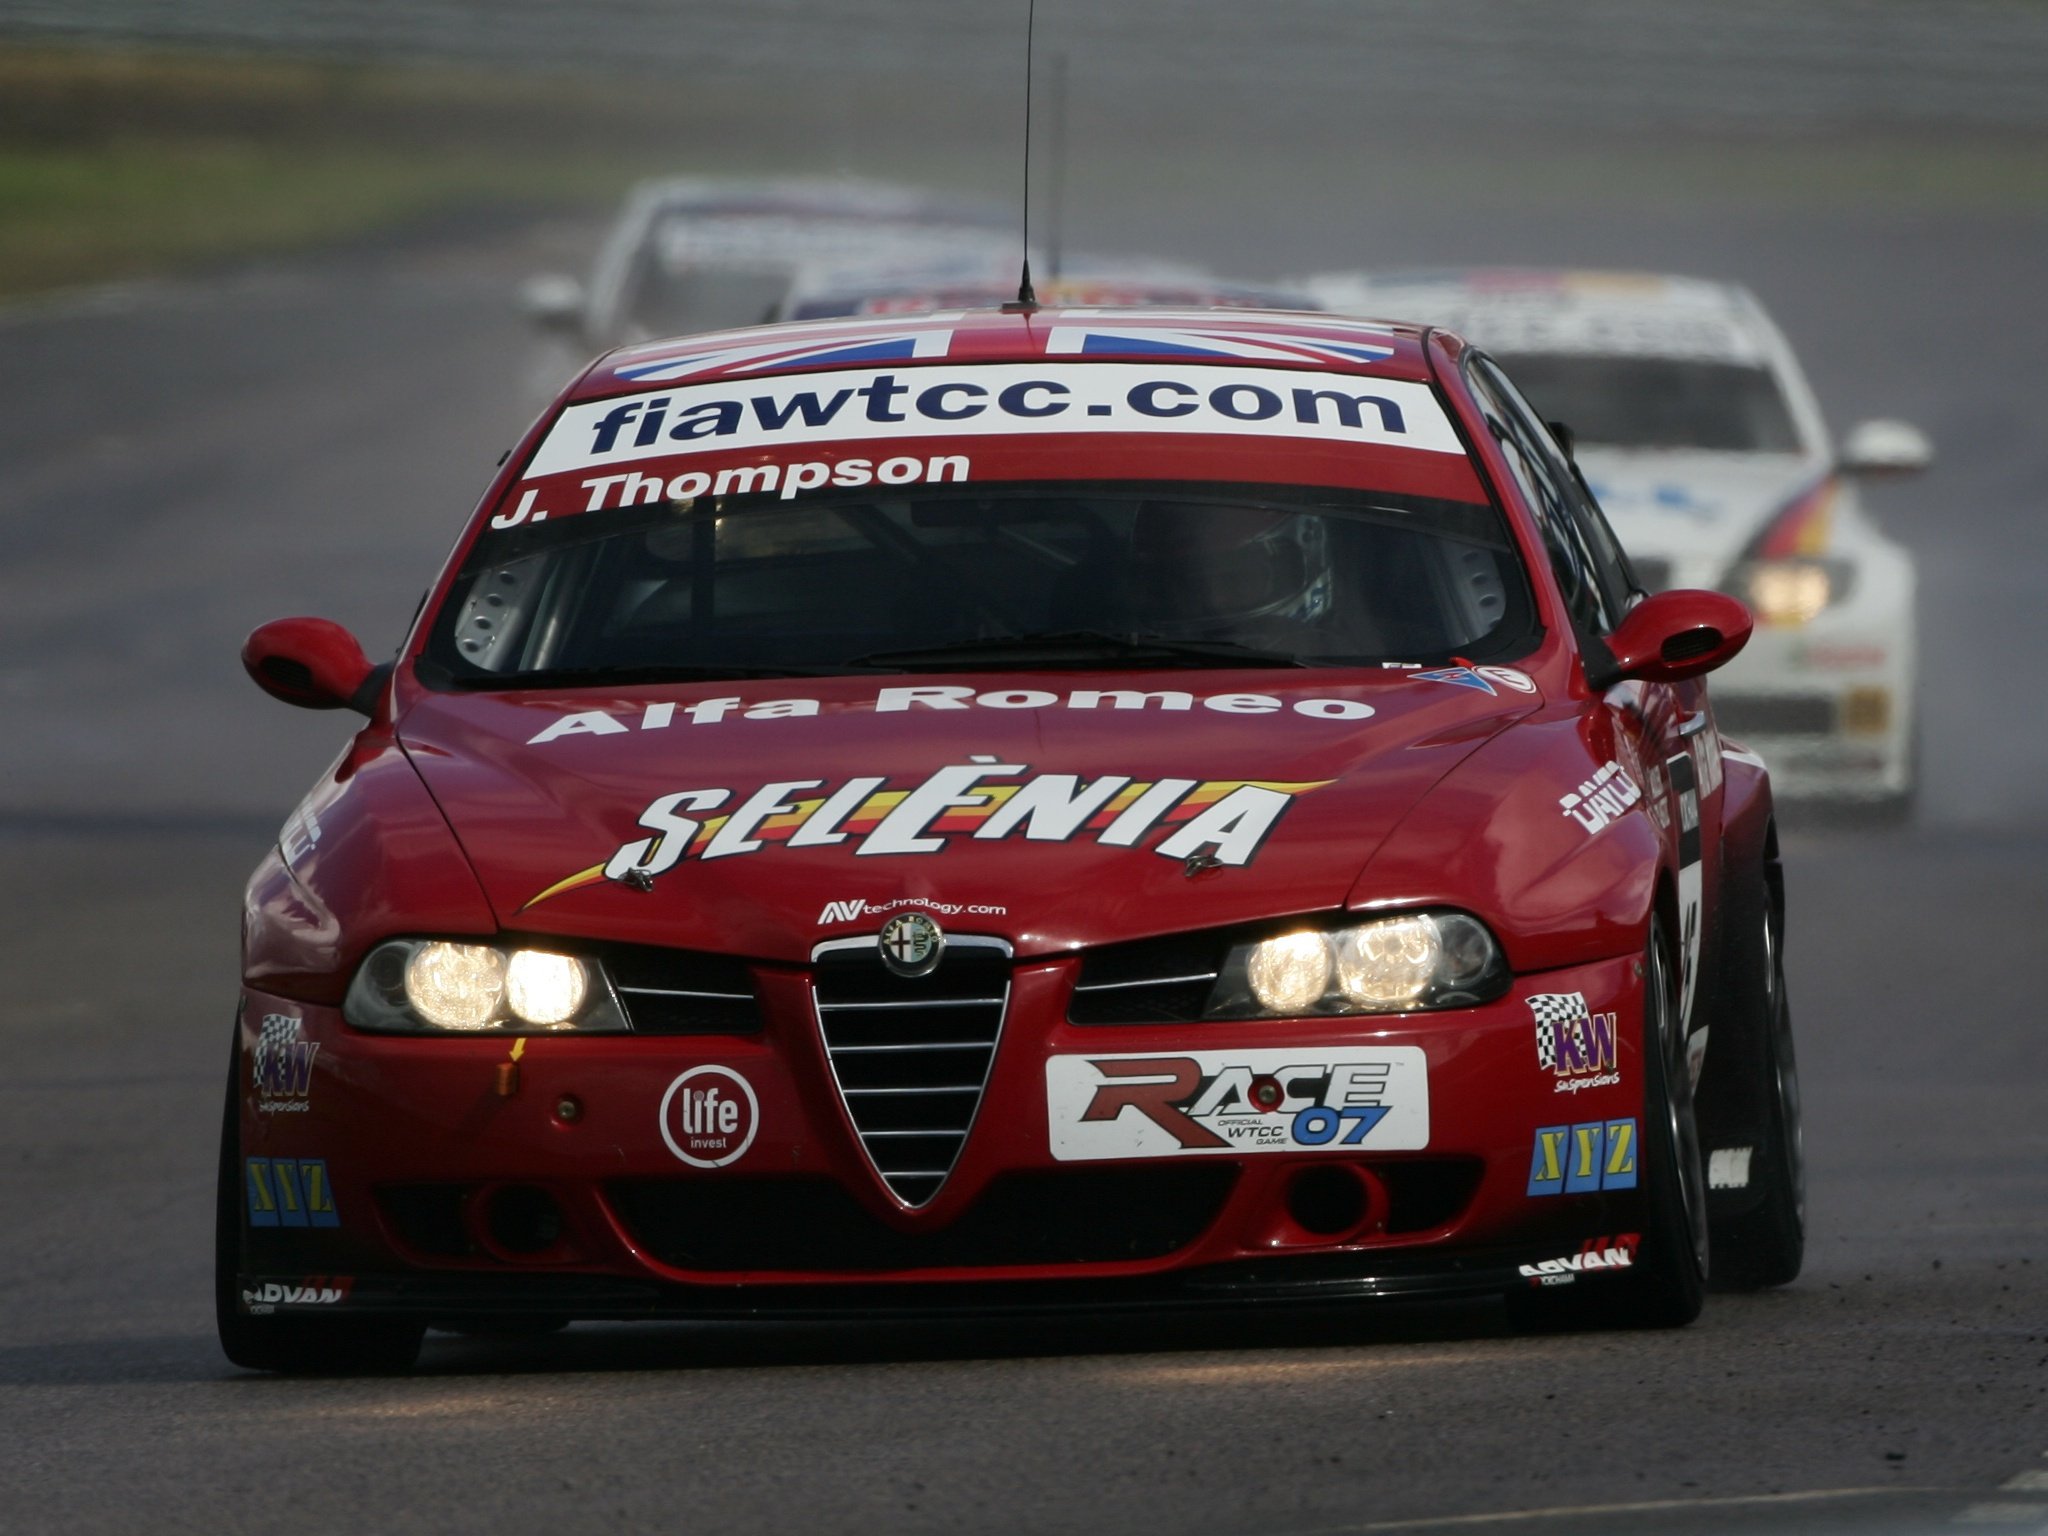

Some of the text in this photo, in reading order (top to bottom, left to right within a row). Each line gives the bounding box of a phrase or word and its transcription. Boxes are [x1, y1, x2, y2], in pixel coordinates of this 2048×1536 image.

[590, 373, 1406, 455] fiawtcc.com
[490, 453, 970, 530] J. Thompson
[526, 685, 1377, 745] Alfa Romeo
[262, 1041, 321, 1097] KW
[1553, 1011, 1617, 1076] KW
[682, 1087, 739, 1134] life
[1078, 1056, 1392, 1149] RACE
[1290, 1105, 1393, 1146] 07
[690, 1137, 727, 1149] invest
[1227, 1125, 1284, 1138] WTCC
[1535, 1123, 1634, 1181] XYZ
[249, 1162, 333, 1213] XYZ
[1518, 1246, 1633, 1277] ADVAN
